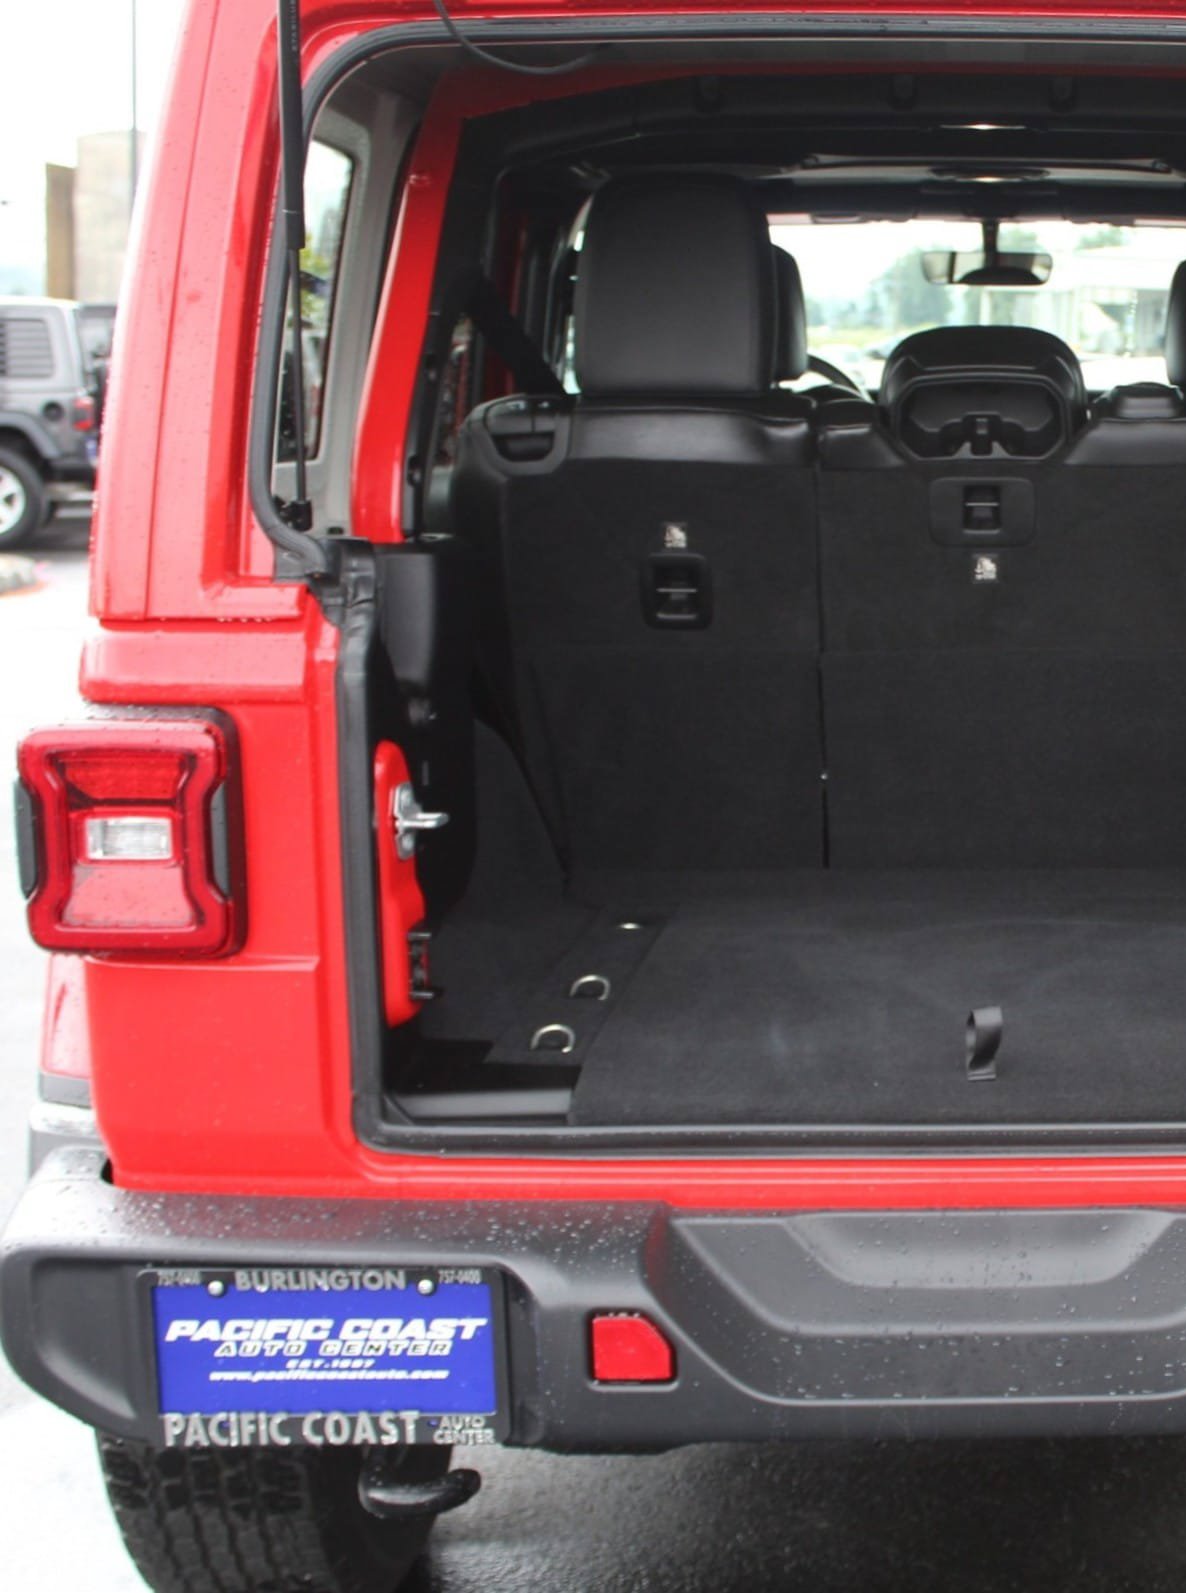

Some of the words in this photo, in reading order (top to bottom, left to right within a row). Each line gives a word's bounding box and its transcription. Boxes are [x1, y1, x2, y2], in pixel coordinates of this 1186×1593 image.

[235, 1270, 406, 1291] BURLINGTON
[165, 1318, 334, 1341] PACIFIC
[339, 1318, 488, 1340] COAST
[214, 1340, 307, 1357] AUTO
[319, 1340, 453, 1356] CENTER
[164, 1411, 291, 1447] PACIFIC
[303, 1410, 419, 1445] COAST
[439, 1415, 485, 1429] AUTO
[433, 1429, 496, 1445] CENTER
